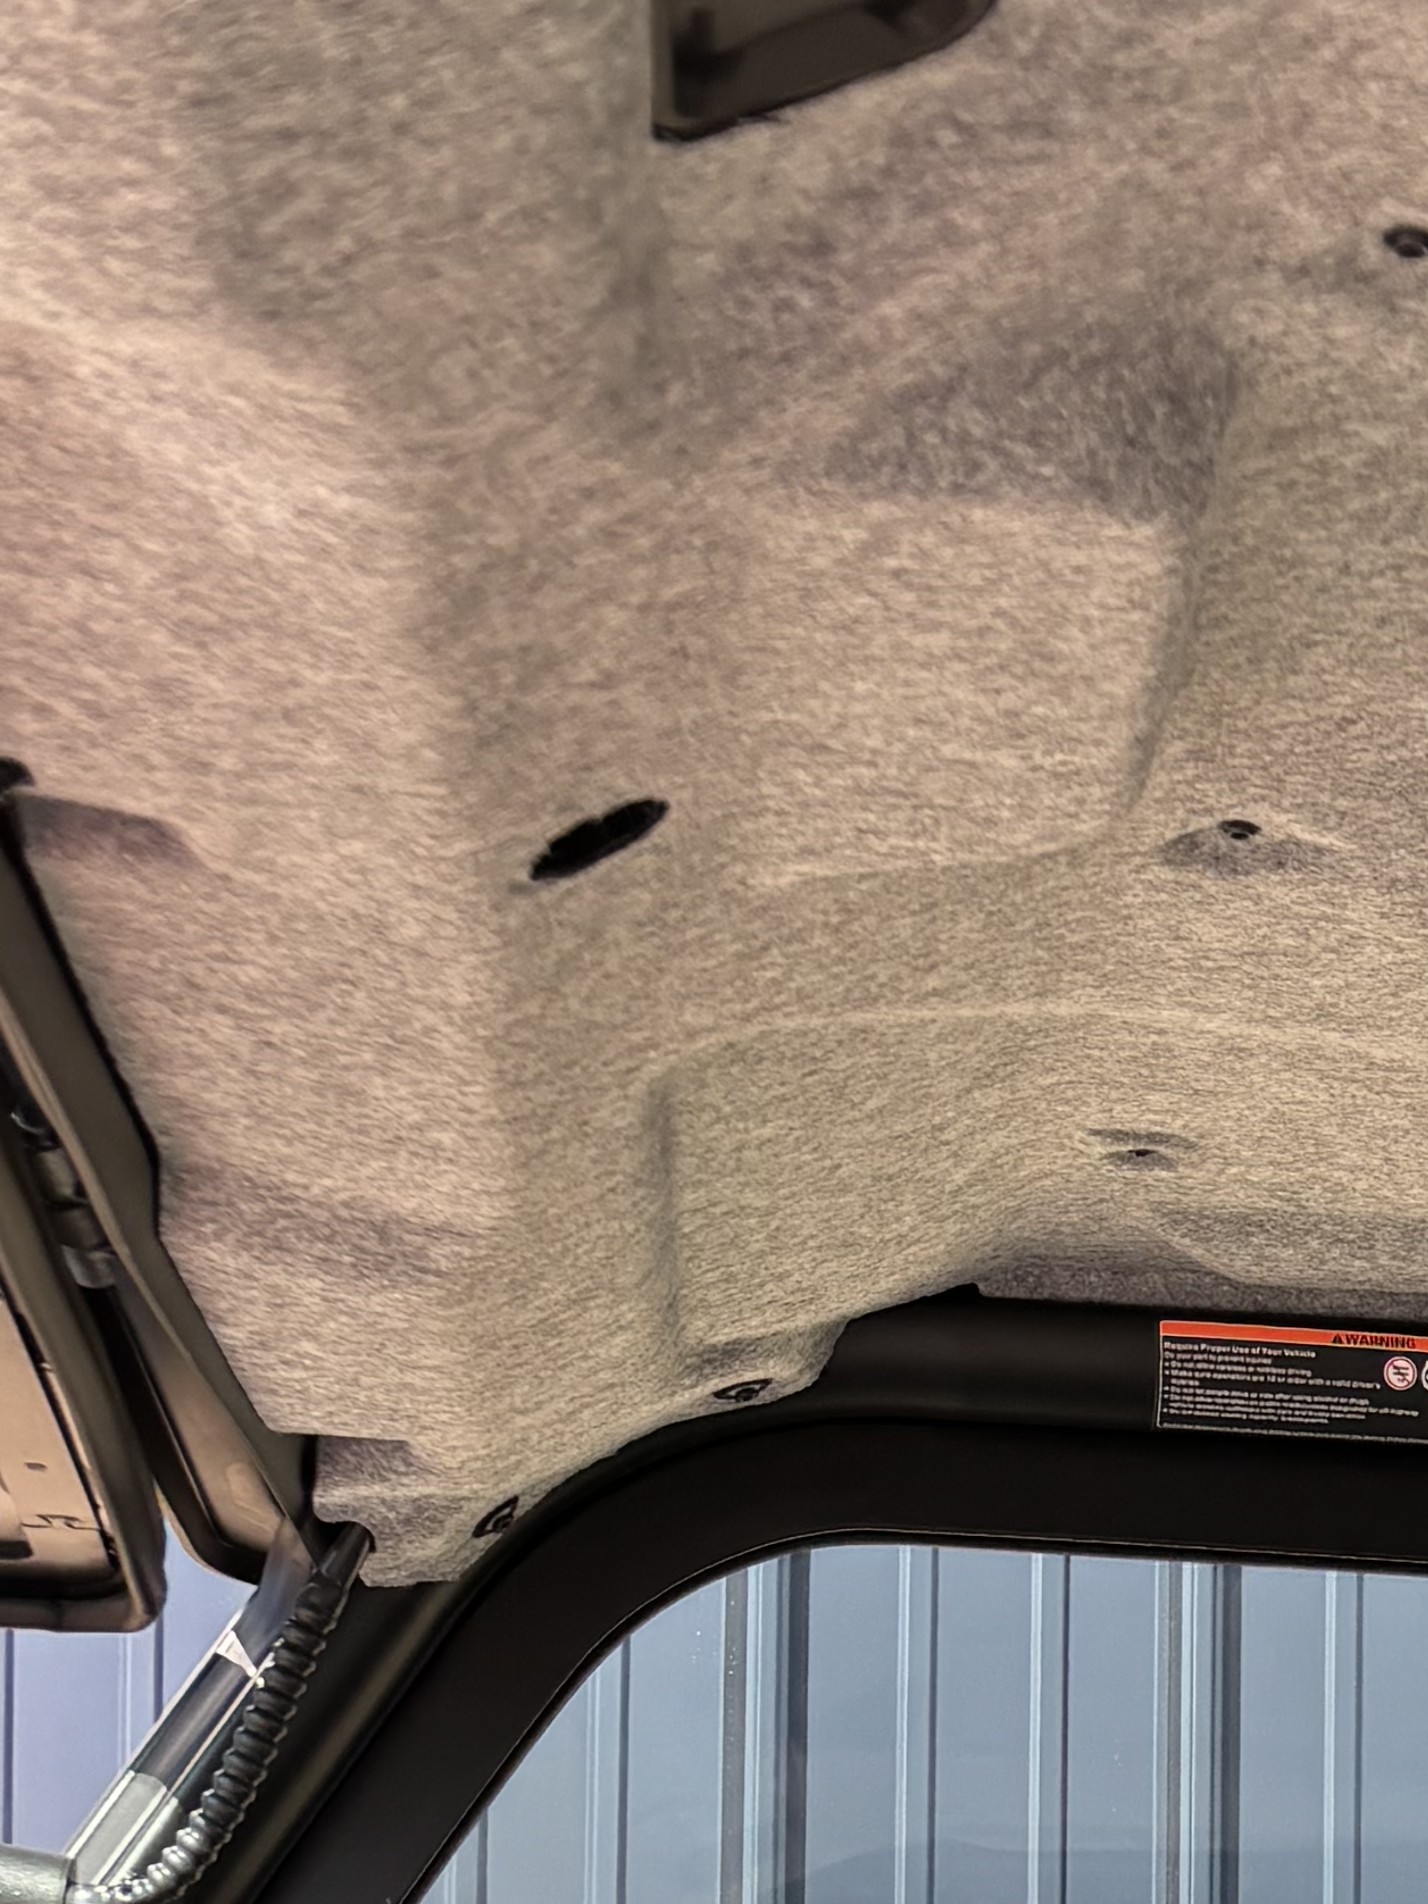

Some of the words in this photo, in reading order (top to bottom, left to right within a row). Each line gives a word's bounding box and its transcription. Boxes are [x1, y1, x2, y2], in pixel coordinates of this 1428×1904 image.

[1199, 1343, 1230, 1353] Proper
[1250, 1346, 1260, 1354] of
[1347, 1333, 1417, 1350] WARNING
